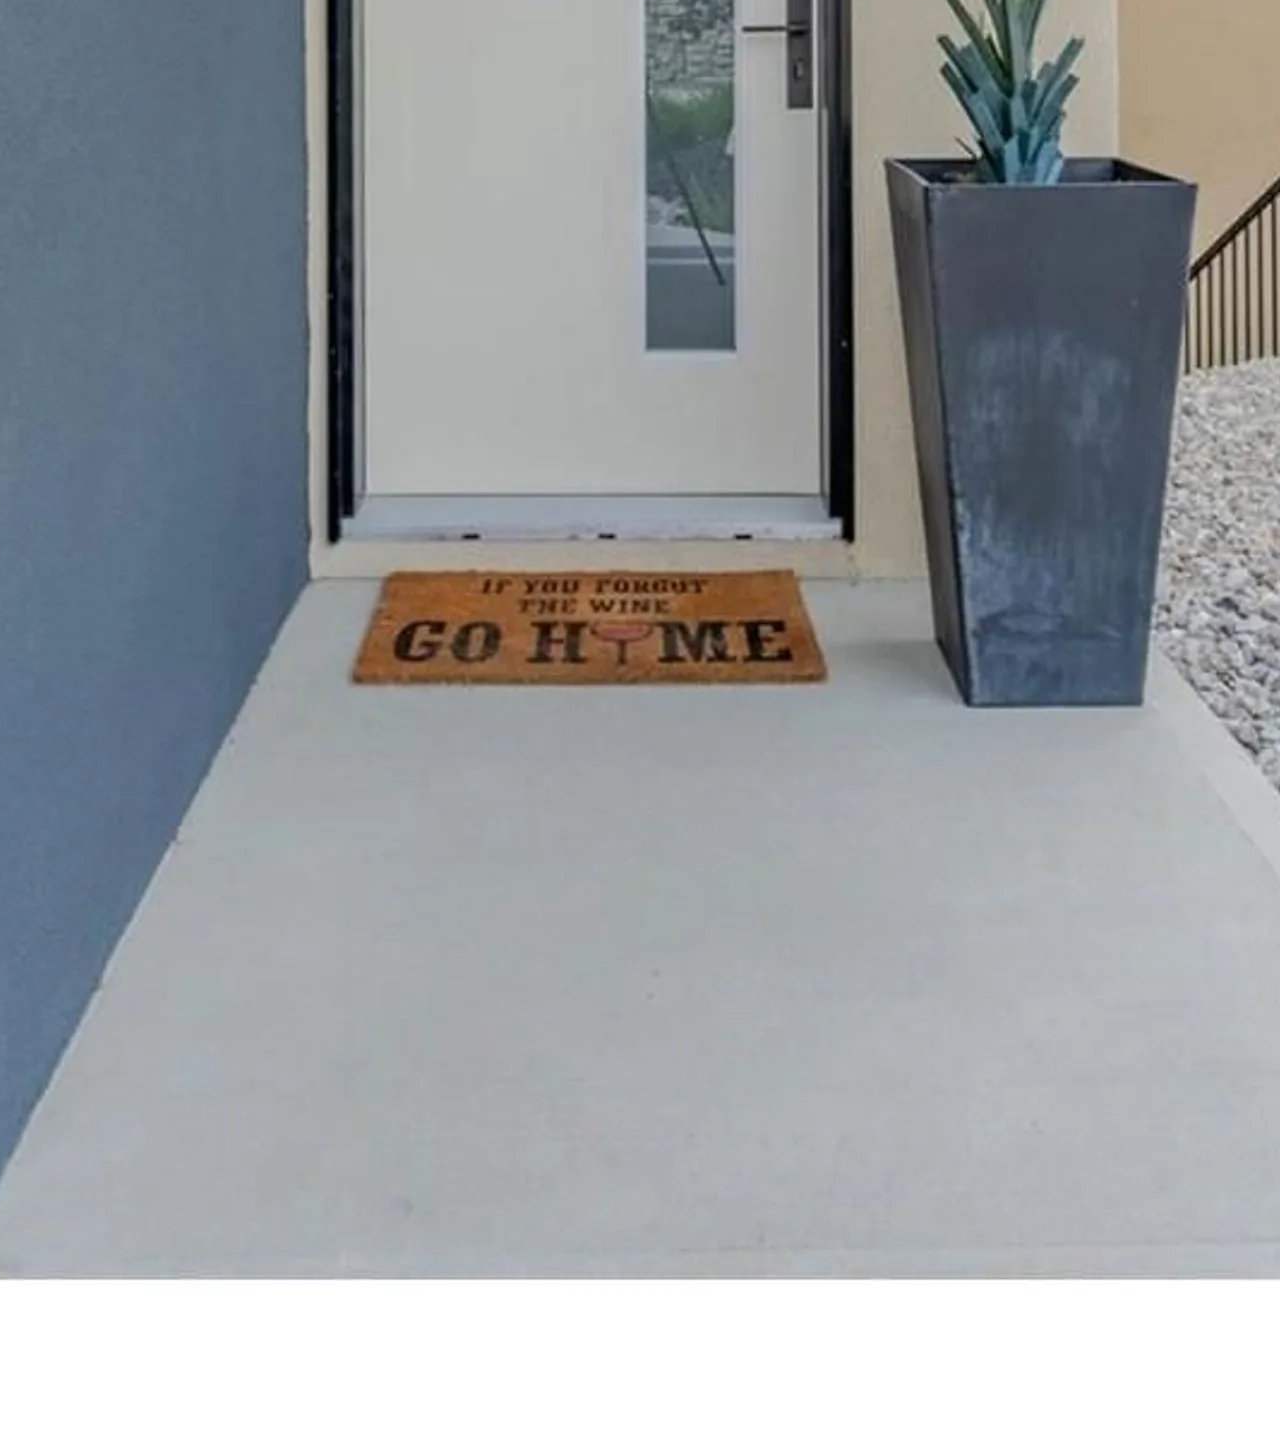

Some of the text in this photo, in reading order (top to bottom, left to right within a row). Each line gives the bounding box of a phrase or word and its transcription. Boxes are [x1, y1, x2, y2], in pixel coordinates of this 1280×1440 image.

[481, 578, 708, 595] IF YOU FORGOT
[518, 597, 671, 615] THE WINE
[394, 620, 794, 665] GO HME
